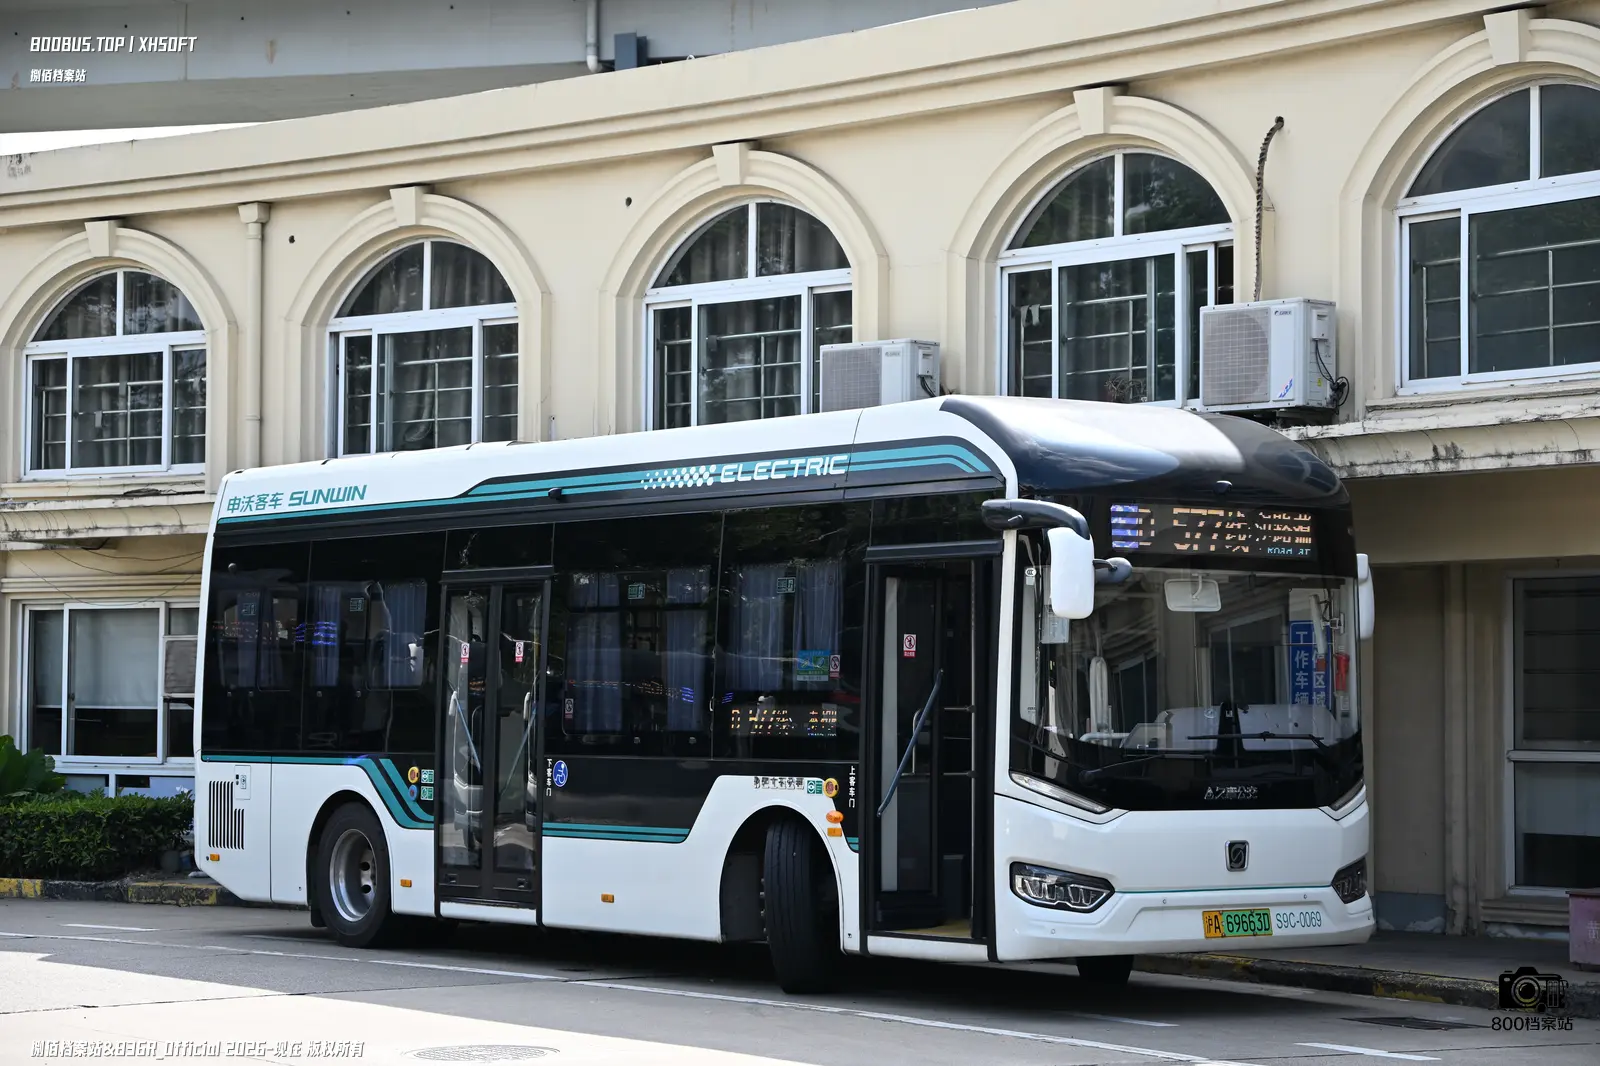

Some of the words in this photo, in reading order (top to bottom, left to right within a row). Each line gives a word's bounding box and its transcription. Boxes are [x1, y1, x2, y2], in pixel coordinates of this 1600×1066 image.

[720, 455, 848, 483] ELECTRIC
[227, 491, 284, 514] 申沃客车
[288, 484, 367, 507] SUNWIN
[1295, 631, 1309, 705] 工作车辆
[1276, 911, 1322, 929] S9C-0069
